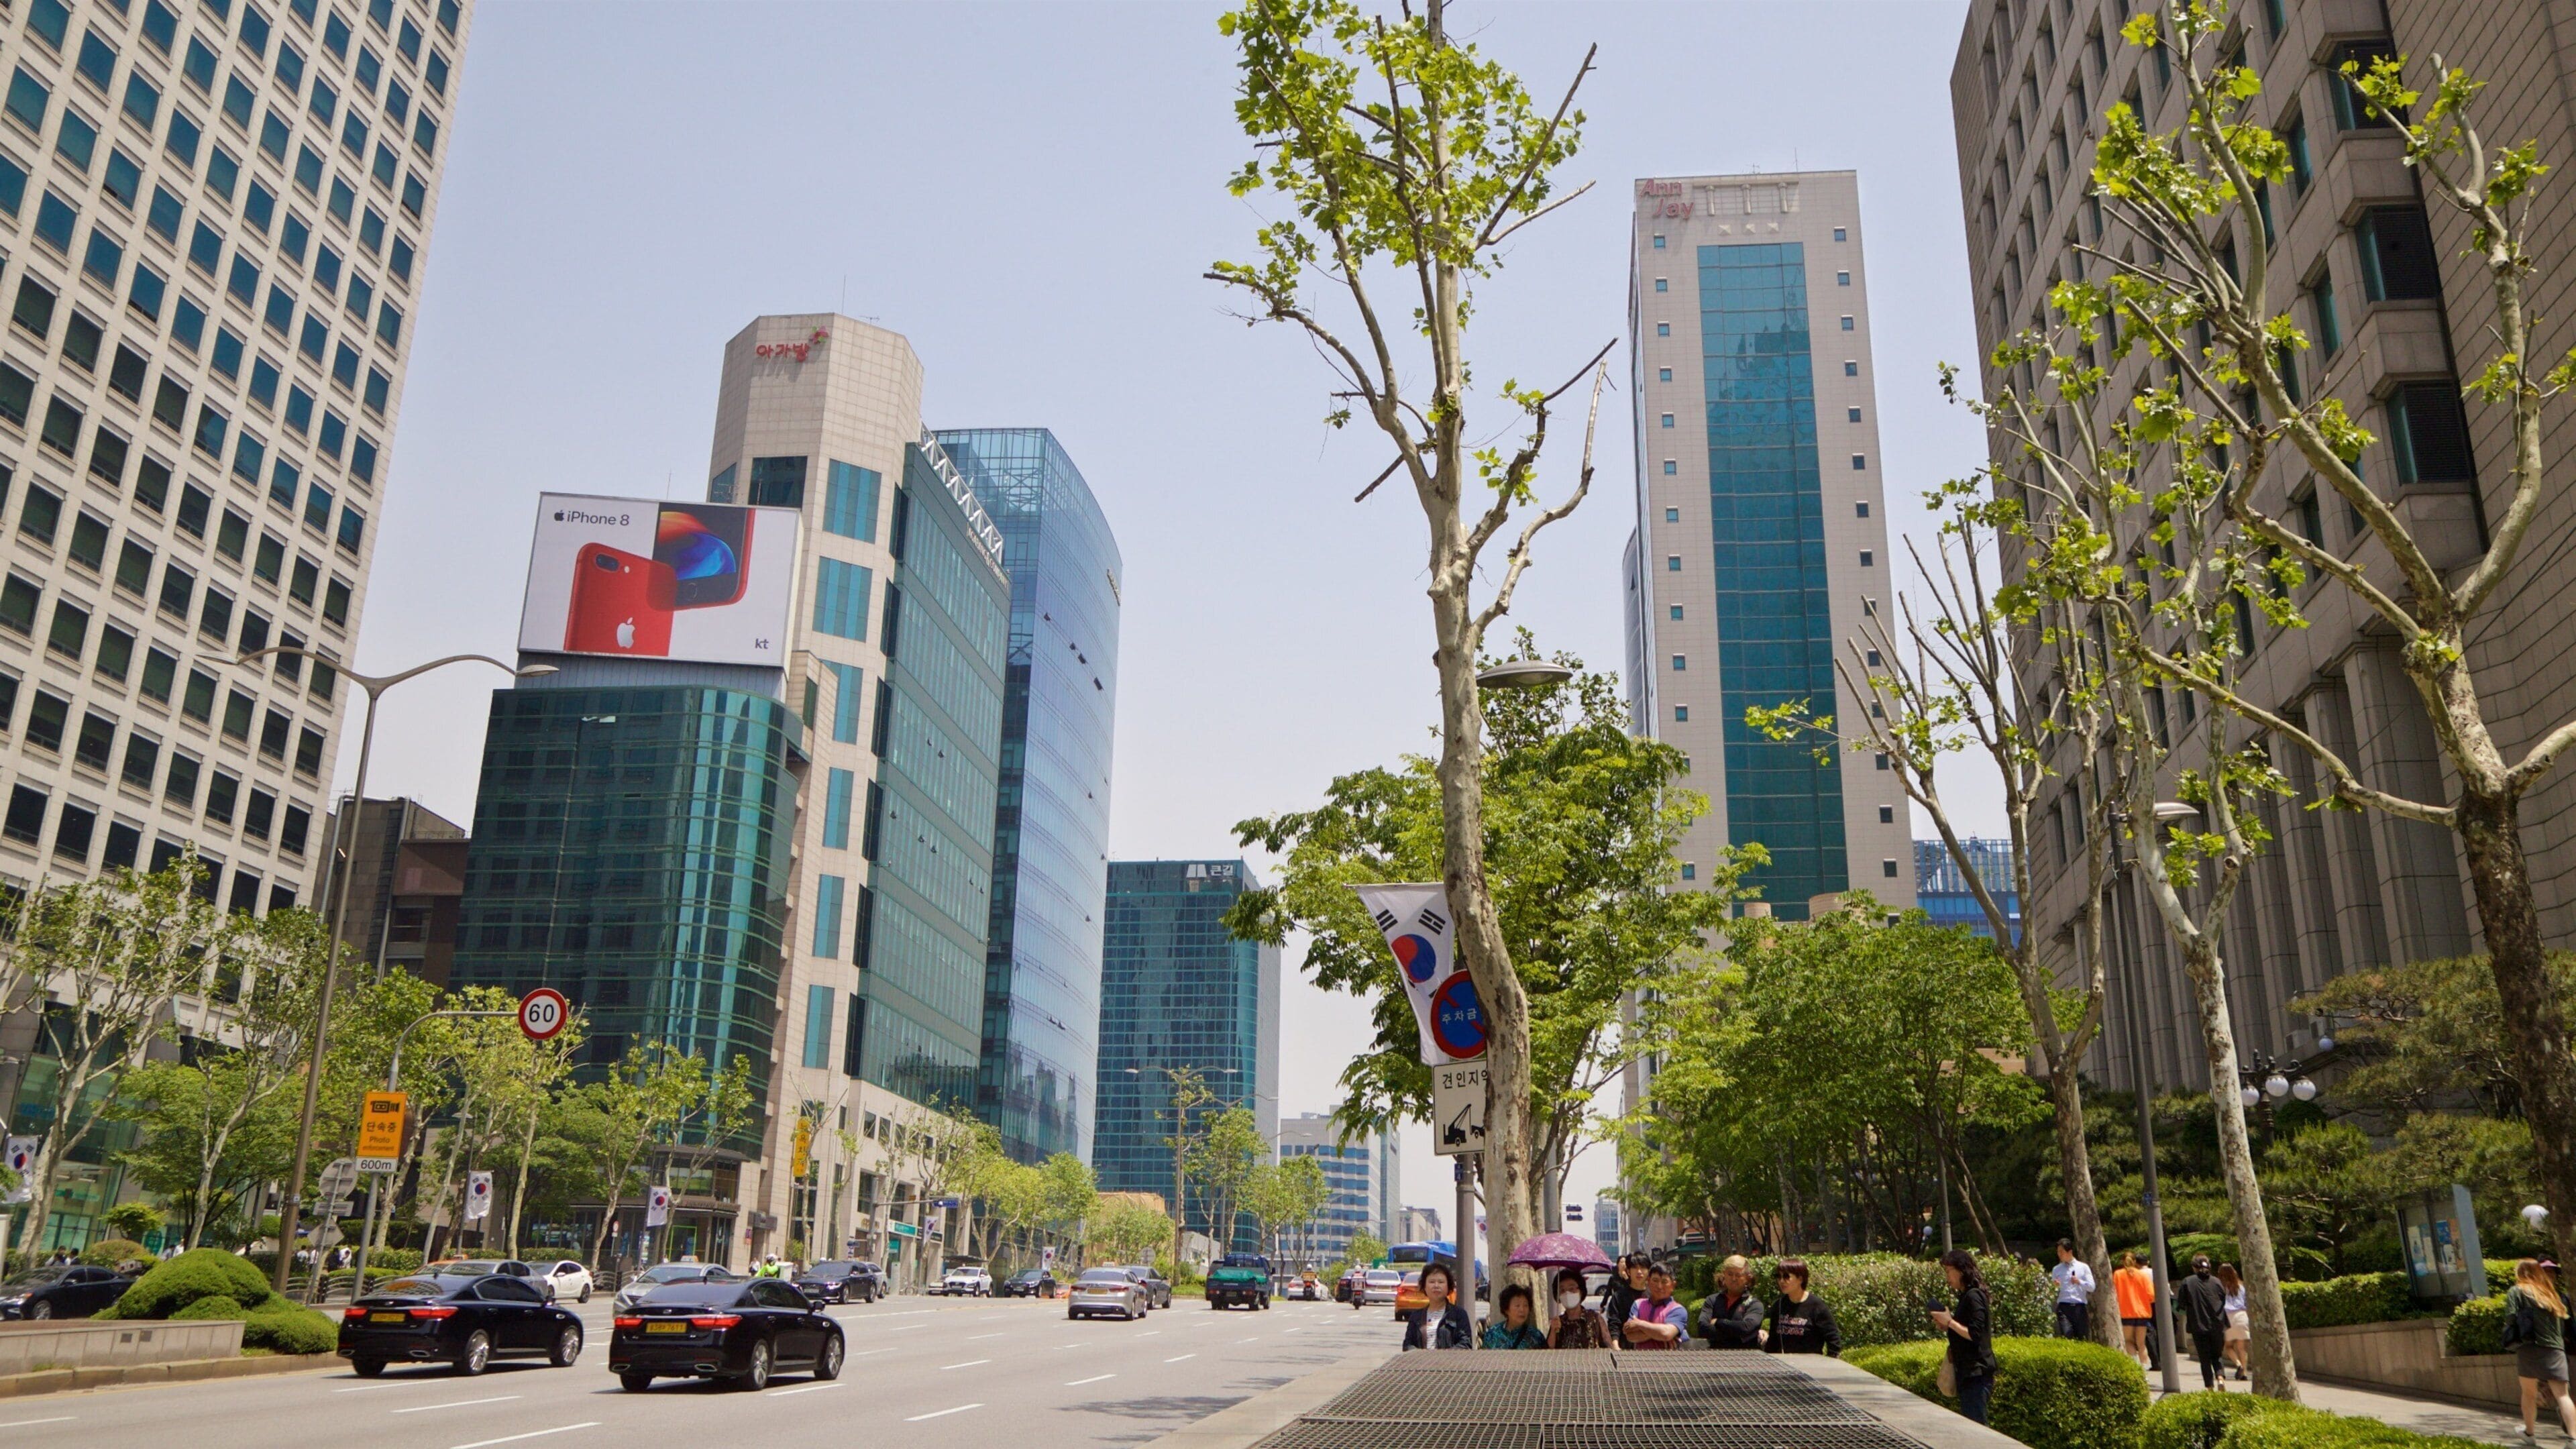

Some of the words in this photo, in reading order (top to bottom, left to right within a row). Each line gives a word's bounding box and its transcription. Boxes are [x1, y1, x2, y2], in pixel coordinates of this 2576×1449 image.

[1640, 178, 1682, 198] Ann
[1653, 199, 1694, 219] Jay
[756, 343, 810, 362] 아가방
[567, 511, 616, 525] iPhone
[620, 515, 629, 525] 8
[755, 638, 769, 649] kt
[1210, 865, 1233, 875] 큰길
[529, 1004, 554, 1022] 60
[1442, 1008, 1477, 1024] 주차금
[367, 1122, 397, 1133] 단속중
[361, 1159, 392, 1169] 600m
